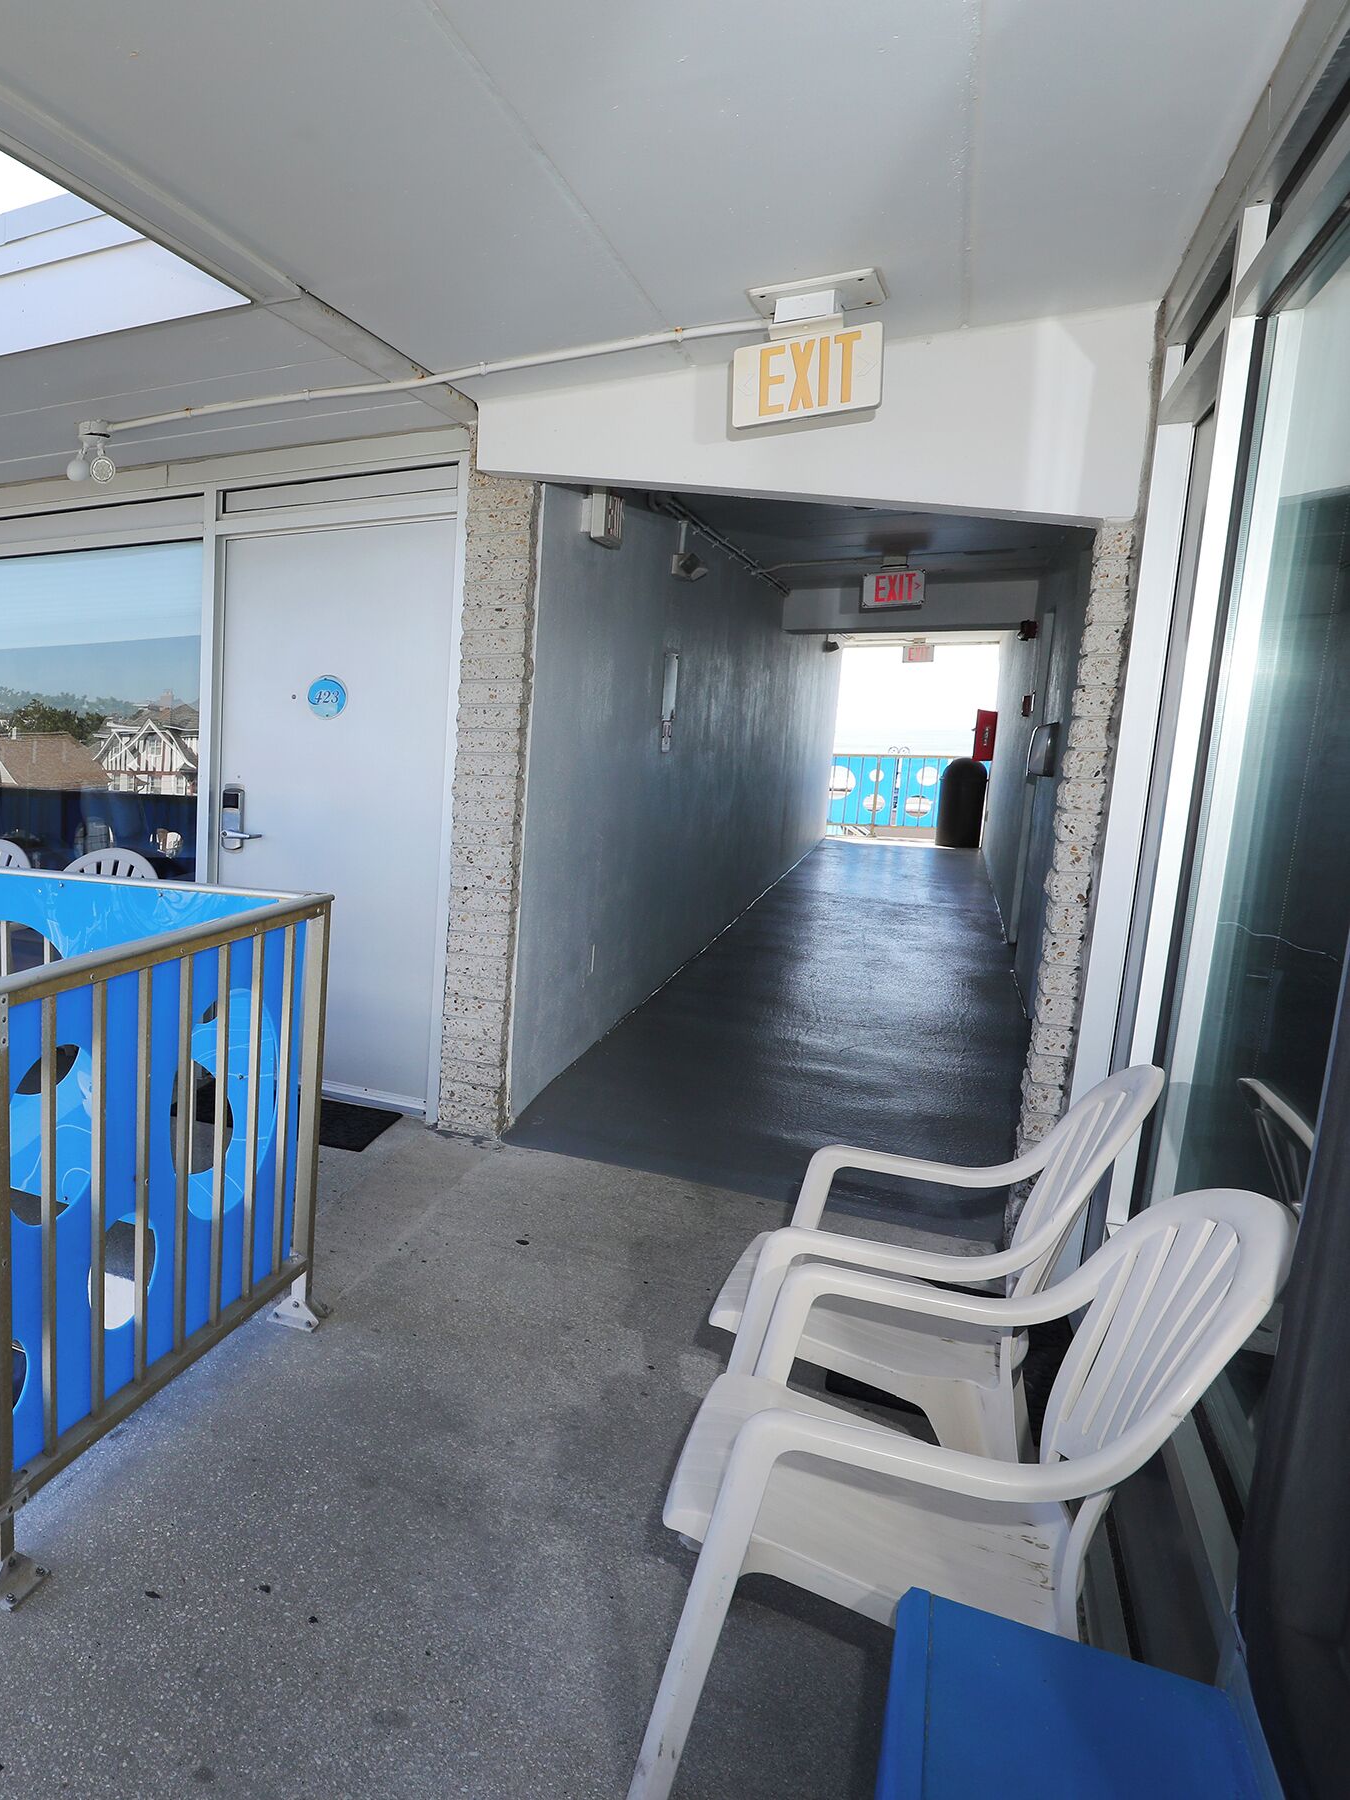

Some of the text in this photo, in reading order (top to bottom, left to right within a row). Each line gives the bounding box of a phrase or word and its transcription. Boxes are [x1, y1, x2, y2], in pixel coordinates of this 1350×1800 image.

[758, 329, 862, 417] EXIT
[874, 573, 917, 603] EXIT
[314, 690, 340, 704] 423
